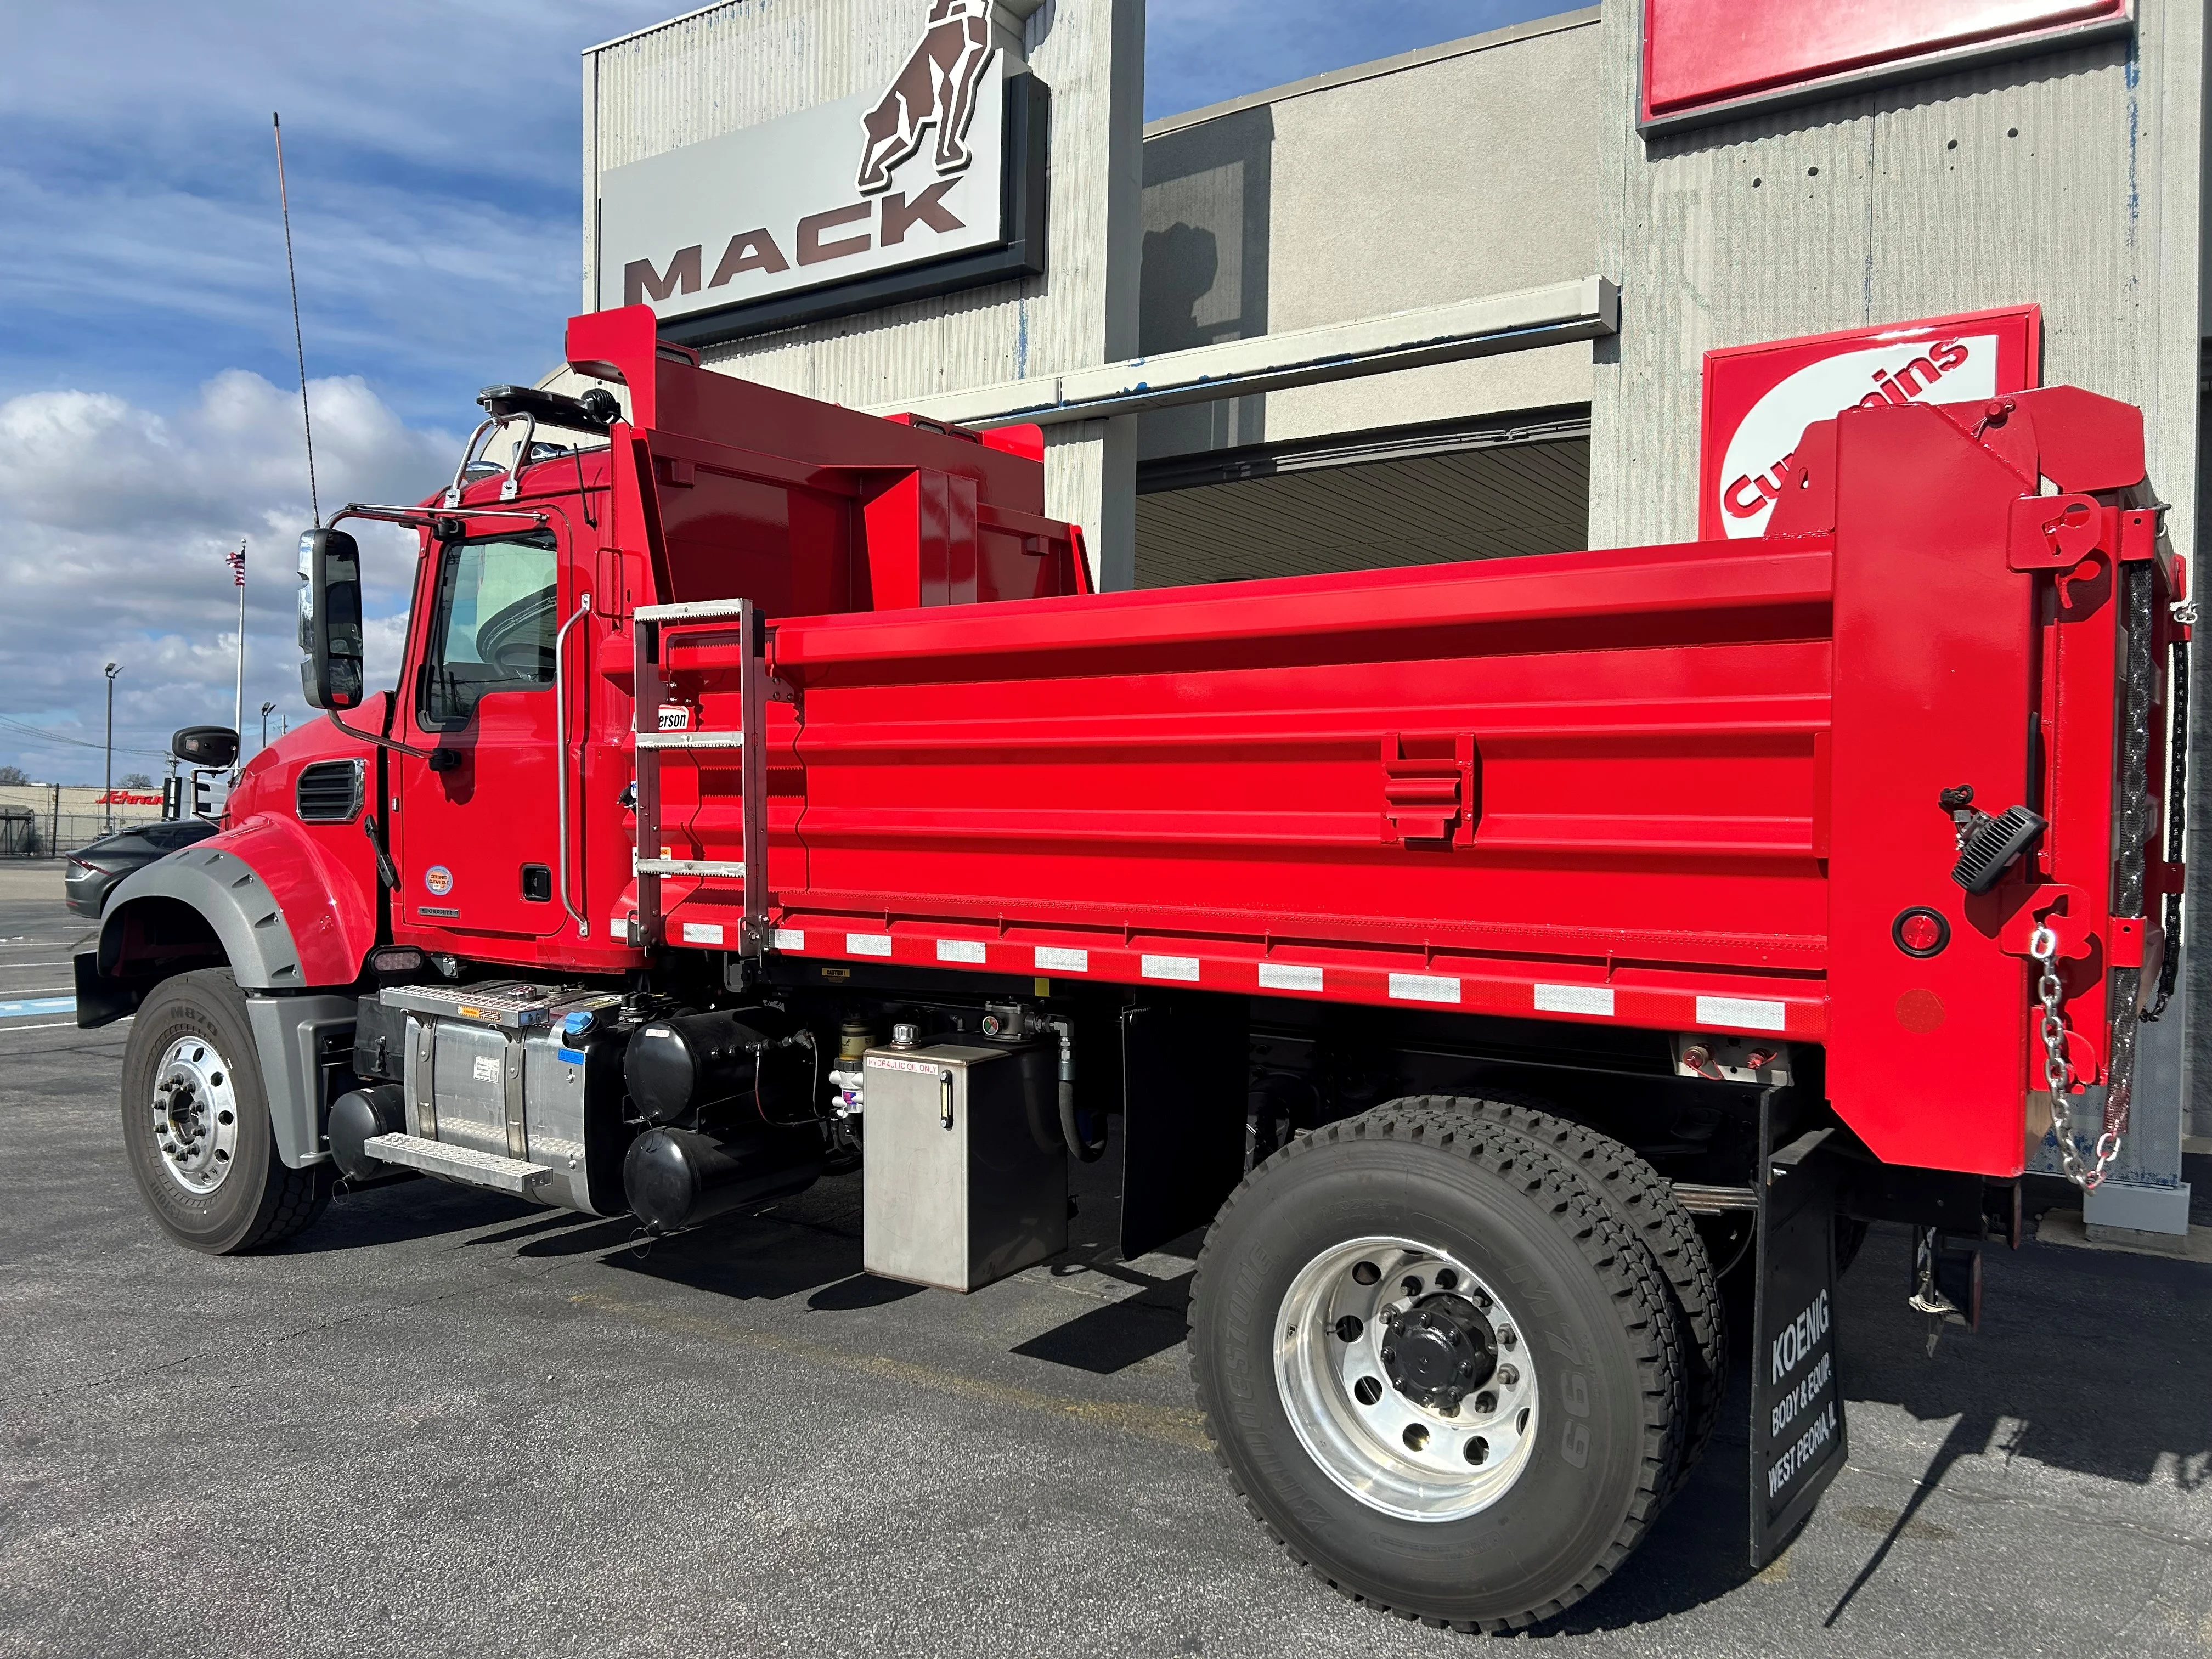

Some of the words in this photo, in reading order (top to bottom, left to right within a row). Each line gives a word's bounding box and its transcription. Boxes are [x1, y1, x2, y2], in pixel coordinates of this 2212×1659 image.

[624, 176, 966, 306] MACK
[1724, 337, 1968, 518] Cuins
[171, 1006, 218, 1036] M870
[868, 1058, 905, 1069] HYDRAULIC
[1771, 1288, 1829, 1385] KOENIG
[1772, 1385, 1800, 1437] BODY
[1799, 1380, 1807, 1409] &
[1808, 1351, 1832, 1402] EQUIP.
[1768, 1448, 1796, 1498] WEST
[1796, 1411, 1829, 1469] PEORIA,
[1829, 1400, 1837, 1430] IL
